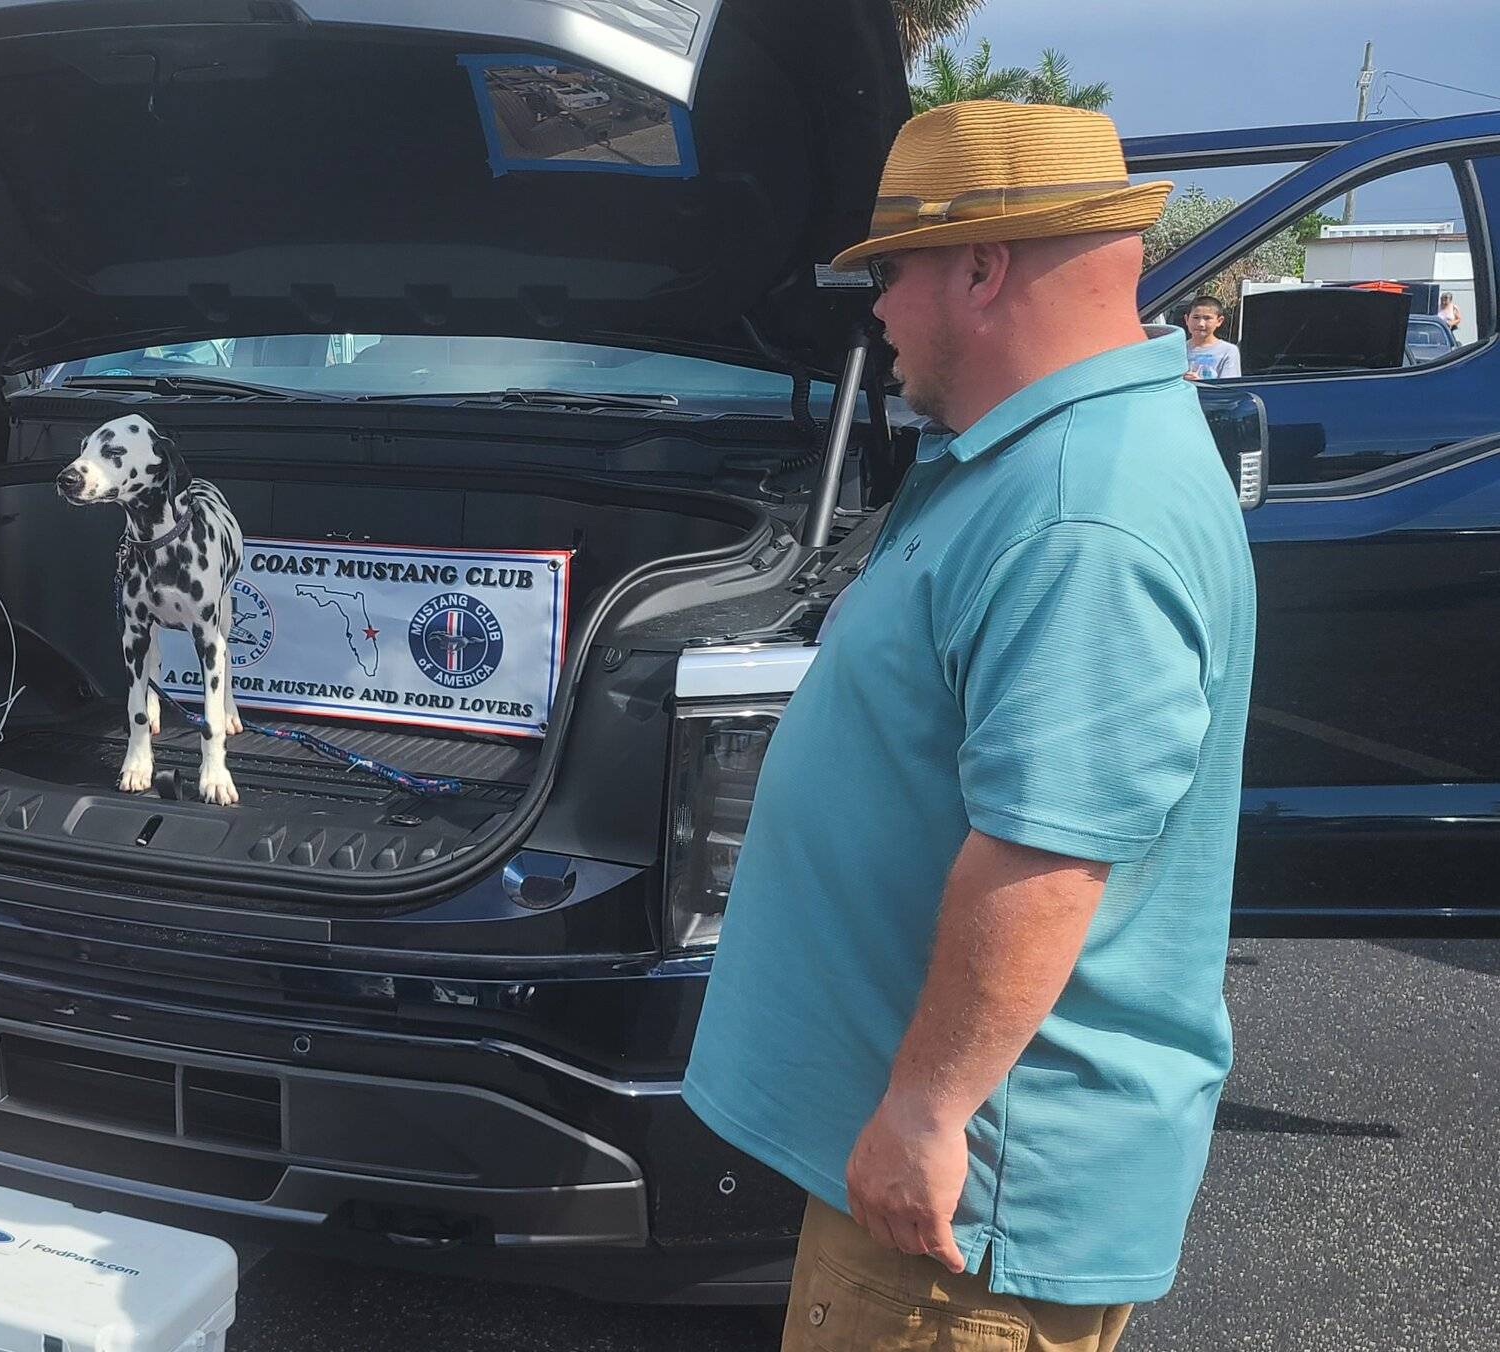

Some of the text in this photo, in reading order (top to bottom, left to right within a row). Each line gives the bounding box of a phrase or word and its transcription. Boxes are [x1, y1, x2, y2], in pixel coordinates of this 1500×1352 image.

[250, 553, 331, 576] COAST
[334, 559, 458, 584] MUSTANG
[465, 567, 534, 589] CLUB
[233, 581, 271, 618] COAST
[411, 594, 501, 642] MUSTANG CLUB
[250, 629, 272, 660] CLUB
[418, 658, 494, 687] of AMERICA
[164, 670, 534, 718] A CL FOR MUSTANG AND FORD LOVERS
[32, 1244, 141, 1277] FordParts.com
